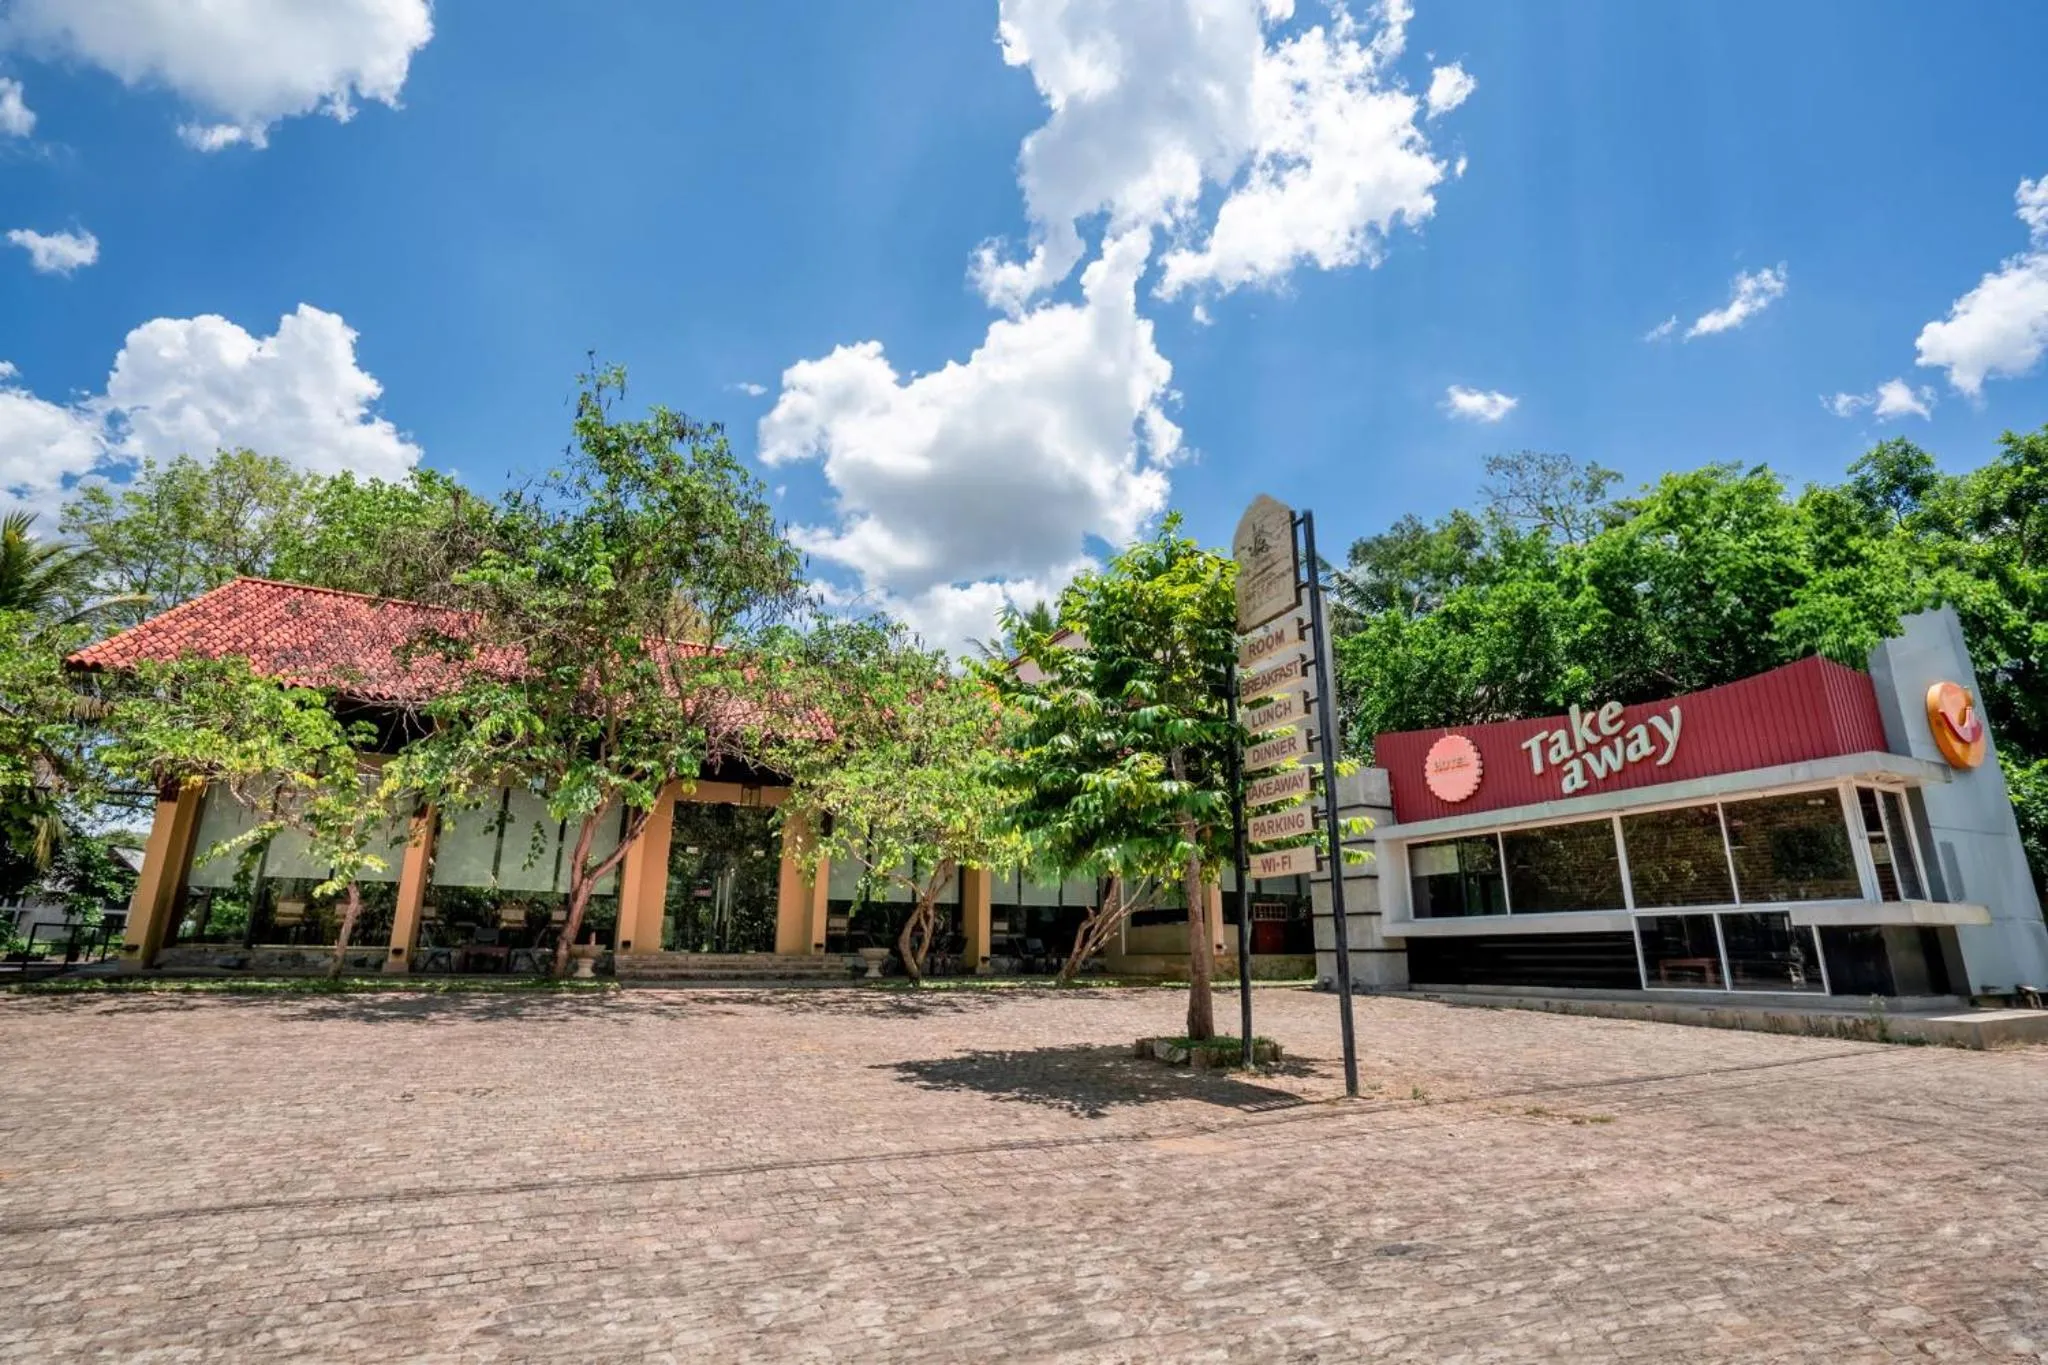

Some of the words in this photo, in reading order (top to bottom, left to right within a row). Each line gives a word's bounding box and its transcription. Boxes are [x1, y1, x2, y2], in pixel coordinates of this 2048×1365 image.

[1248, 629, 1285, 656] ROOM
[1241, 660, 1299, 697] BREAKFAST
[1251, 701, 1292, 728] LUNCH
[1252, 736, 1297, 762] DINNER
[1521, 700, 1624, 776] Take
[1561, 705, 1682, 794] away
[1253, 813, 1305, 837] PARKING
[1261, 855, 1291, 873] WI-FI
